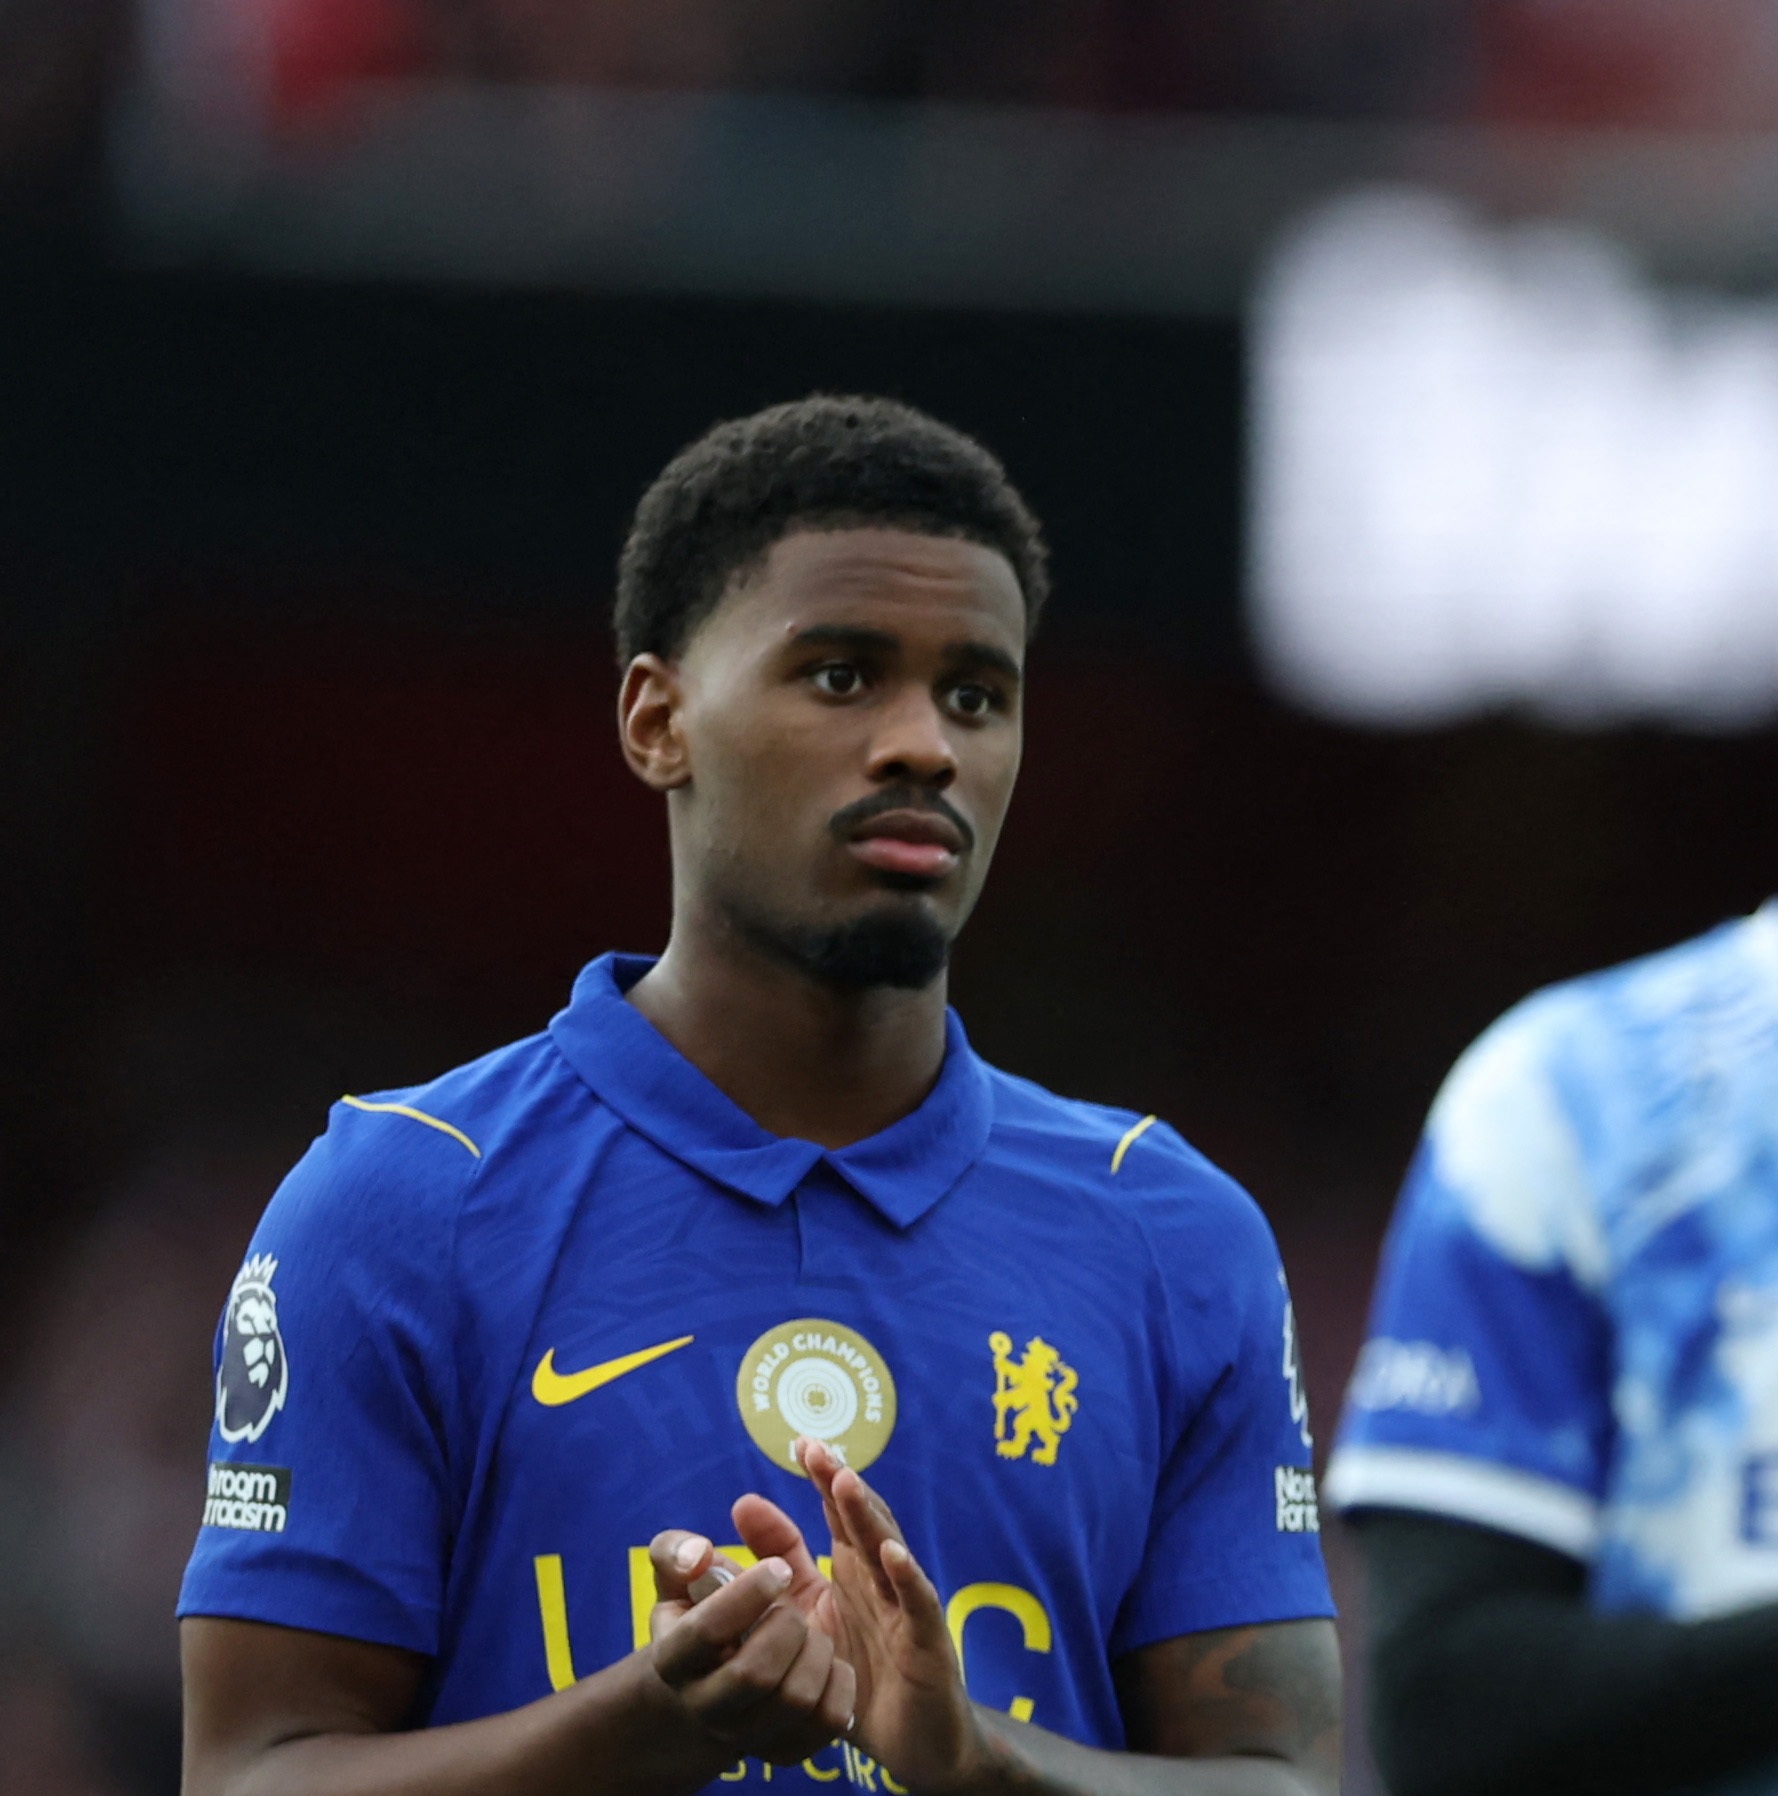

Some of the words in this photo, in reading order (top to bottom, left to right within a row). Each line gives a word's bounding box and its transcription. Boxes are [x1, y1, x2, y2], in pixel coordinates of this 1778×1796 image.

[753, 1341, 791, 1413] WORLD
[792, 1333, 884, 1424] CHAMPIONS
[533, 1545, 1052, 1722] UC
